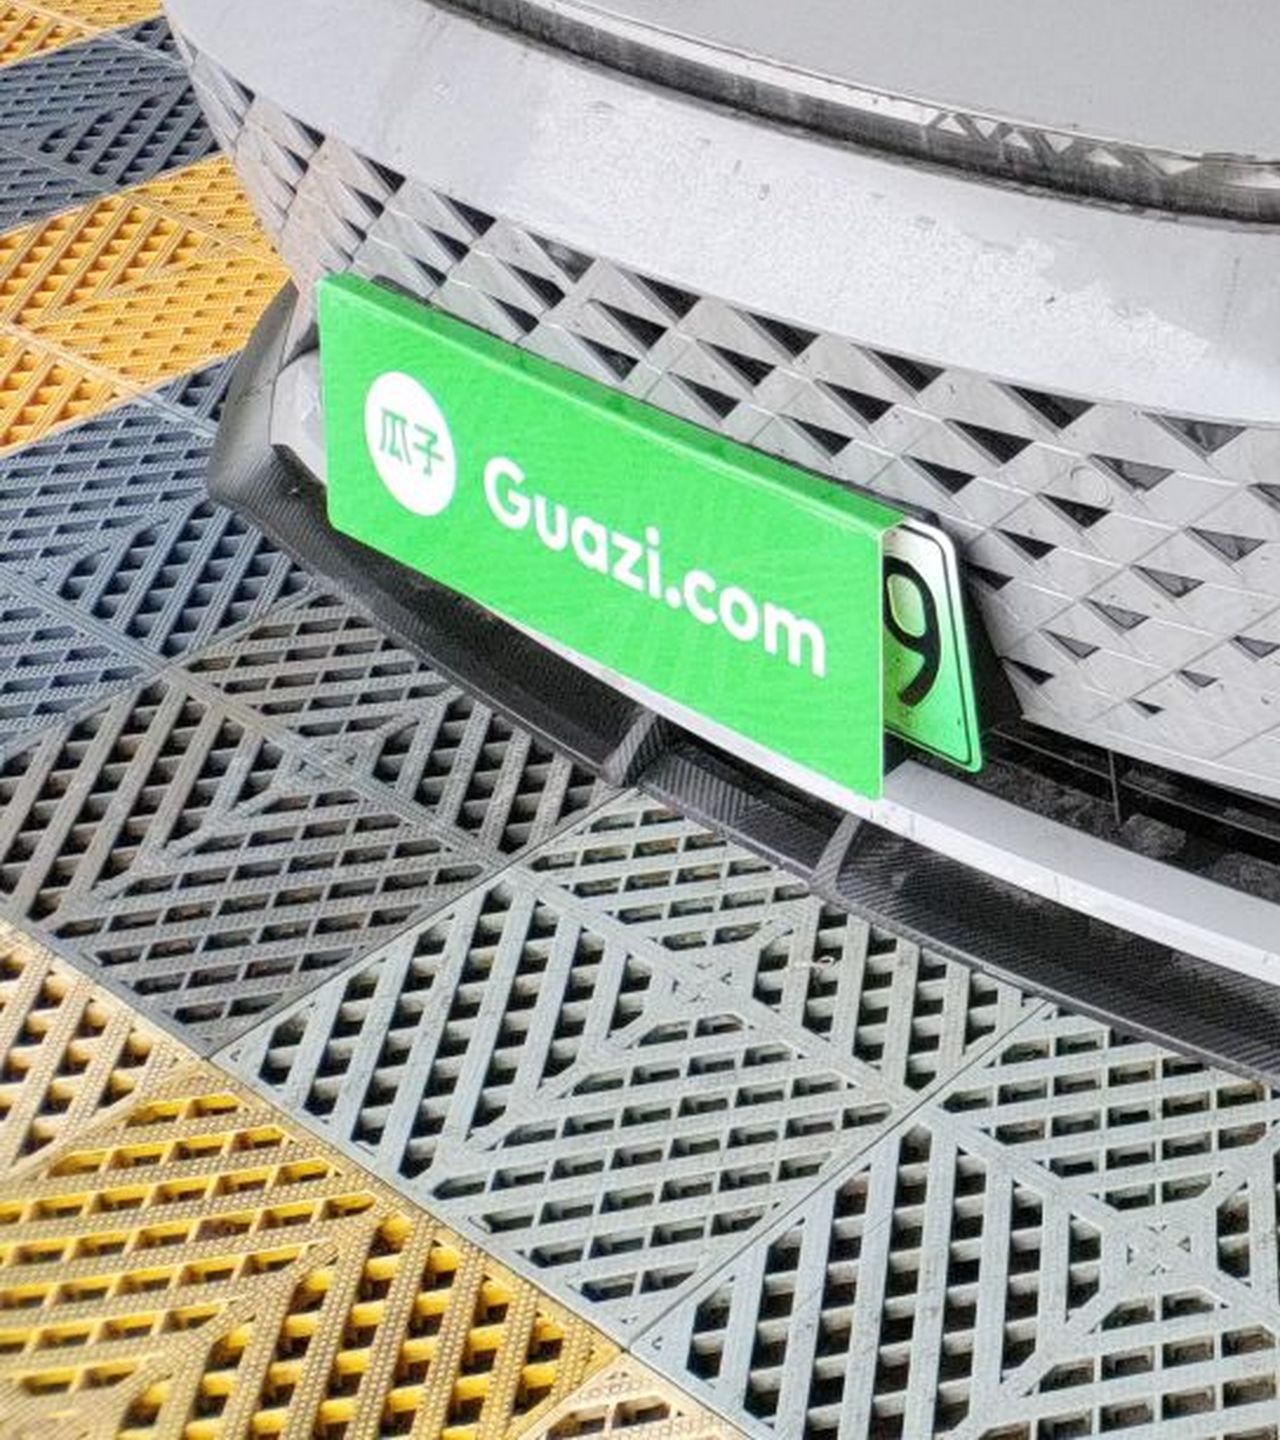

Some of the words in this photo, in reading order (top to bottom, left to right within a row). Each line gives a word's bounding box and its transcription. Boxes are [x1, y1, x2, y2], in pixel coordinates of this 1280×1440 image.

[379, 407, 446, 477] 瓜子
[483, 456, 827, 678] Guazi.com
[882, 554, 942, 708] 9
